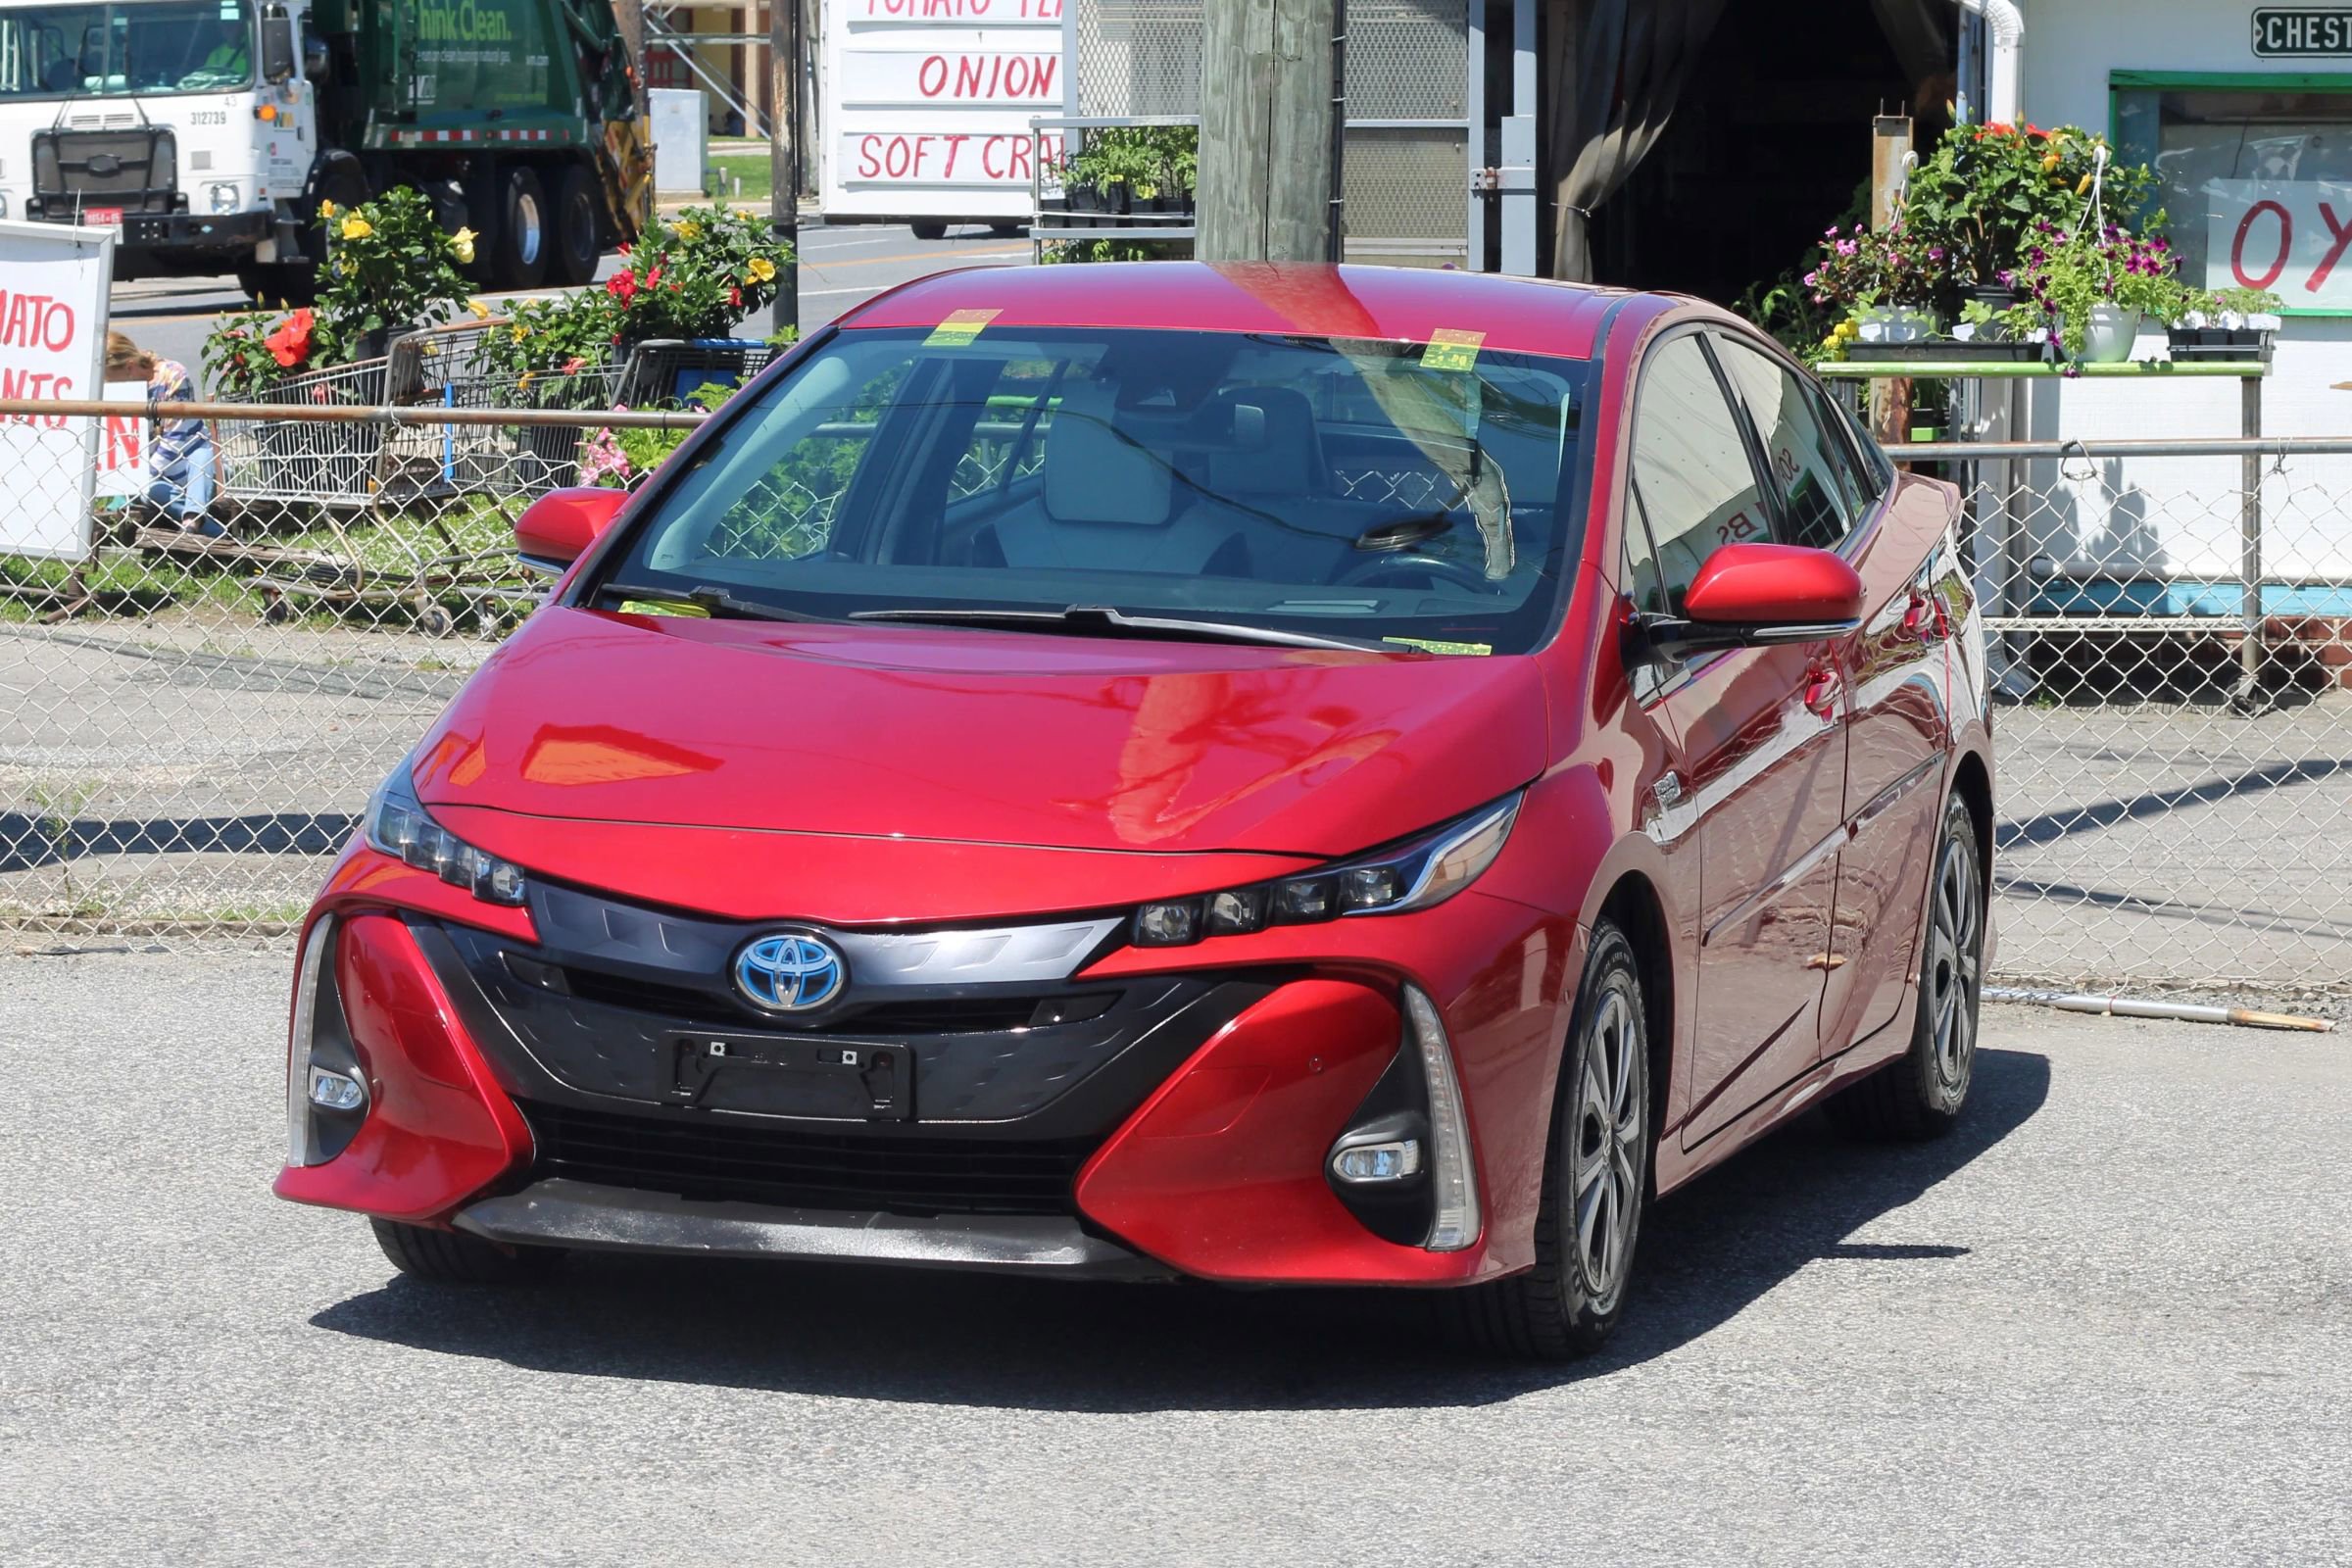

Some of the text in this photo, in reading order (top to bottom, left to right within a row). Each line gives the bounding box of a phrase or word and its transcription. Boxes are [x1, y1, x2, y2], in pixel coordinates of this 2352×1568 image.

[460, 0, 512, 40] Clean.
[2267, 17, 2352, 48] CHEST
[918, 55, 1056, 98] ONION
[190, 111, 227, 126] 312739
[858, 133, 1065, 179] SOFT CRA
